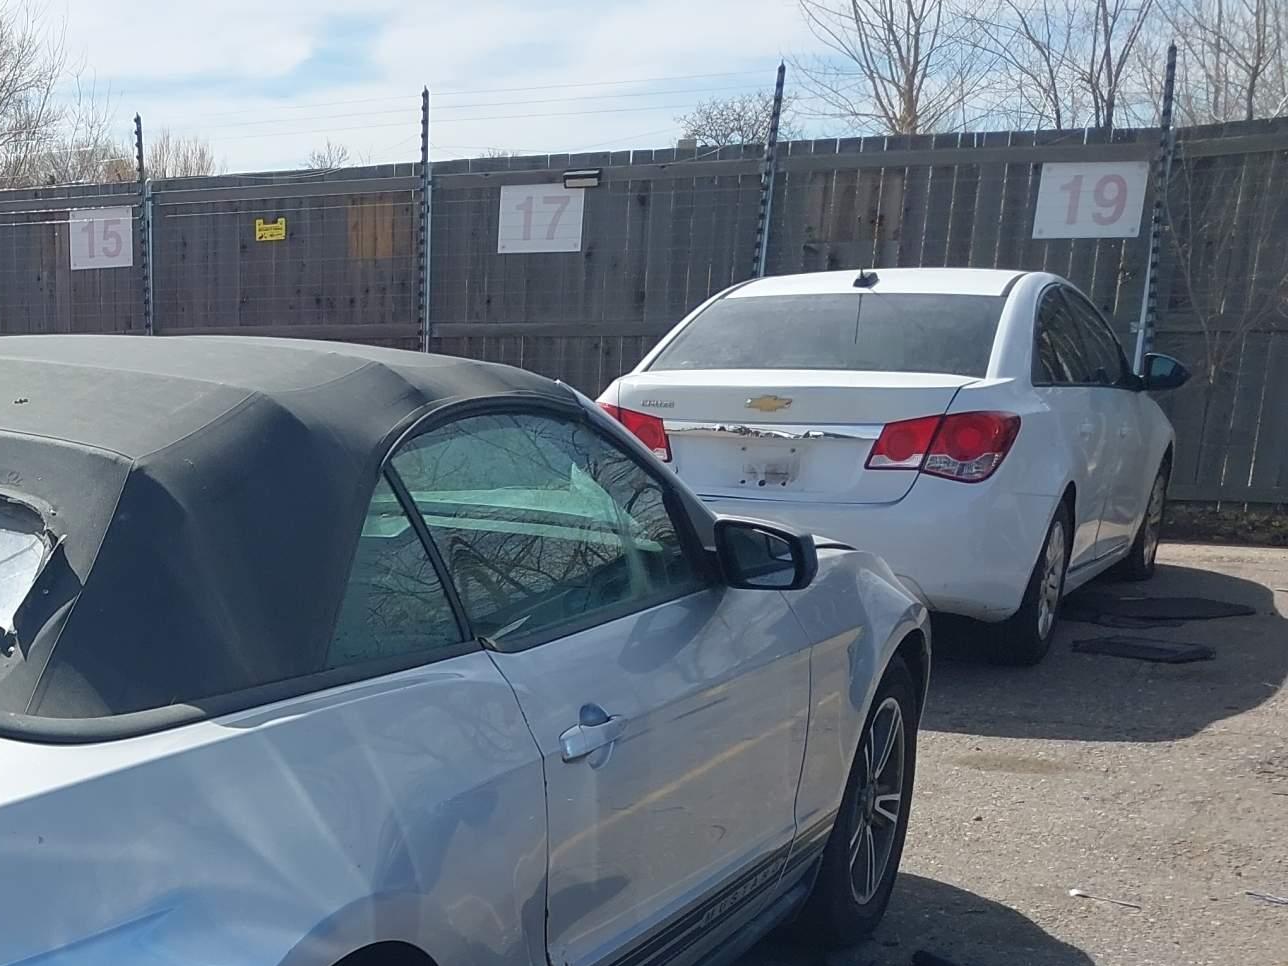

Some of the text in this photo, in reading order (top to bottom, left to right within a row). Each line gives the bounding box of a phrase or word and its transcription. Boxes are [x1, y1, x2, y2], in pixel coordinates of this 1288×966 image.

[515, 195, 570, 240] 17
[1060, 174, 1128, 226] 19
[81, 215, 123, 259] 15
